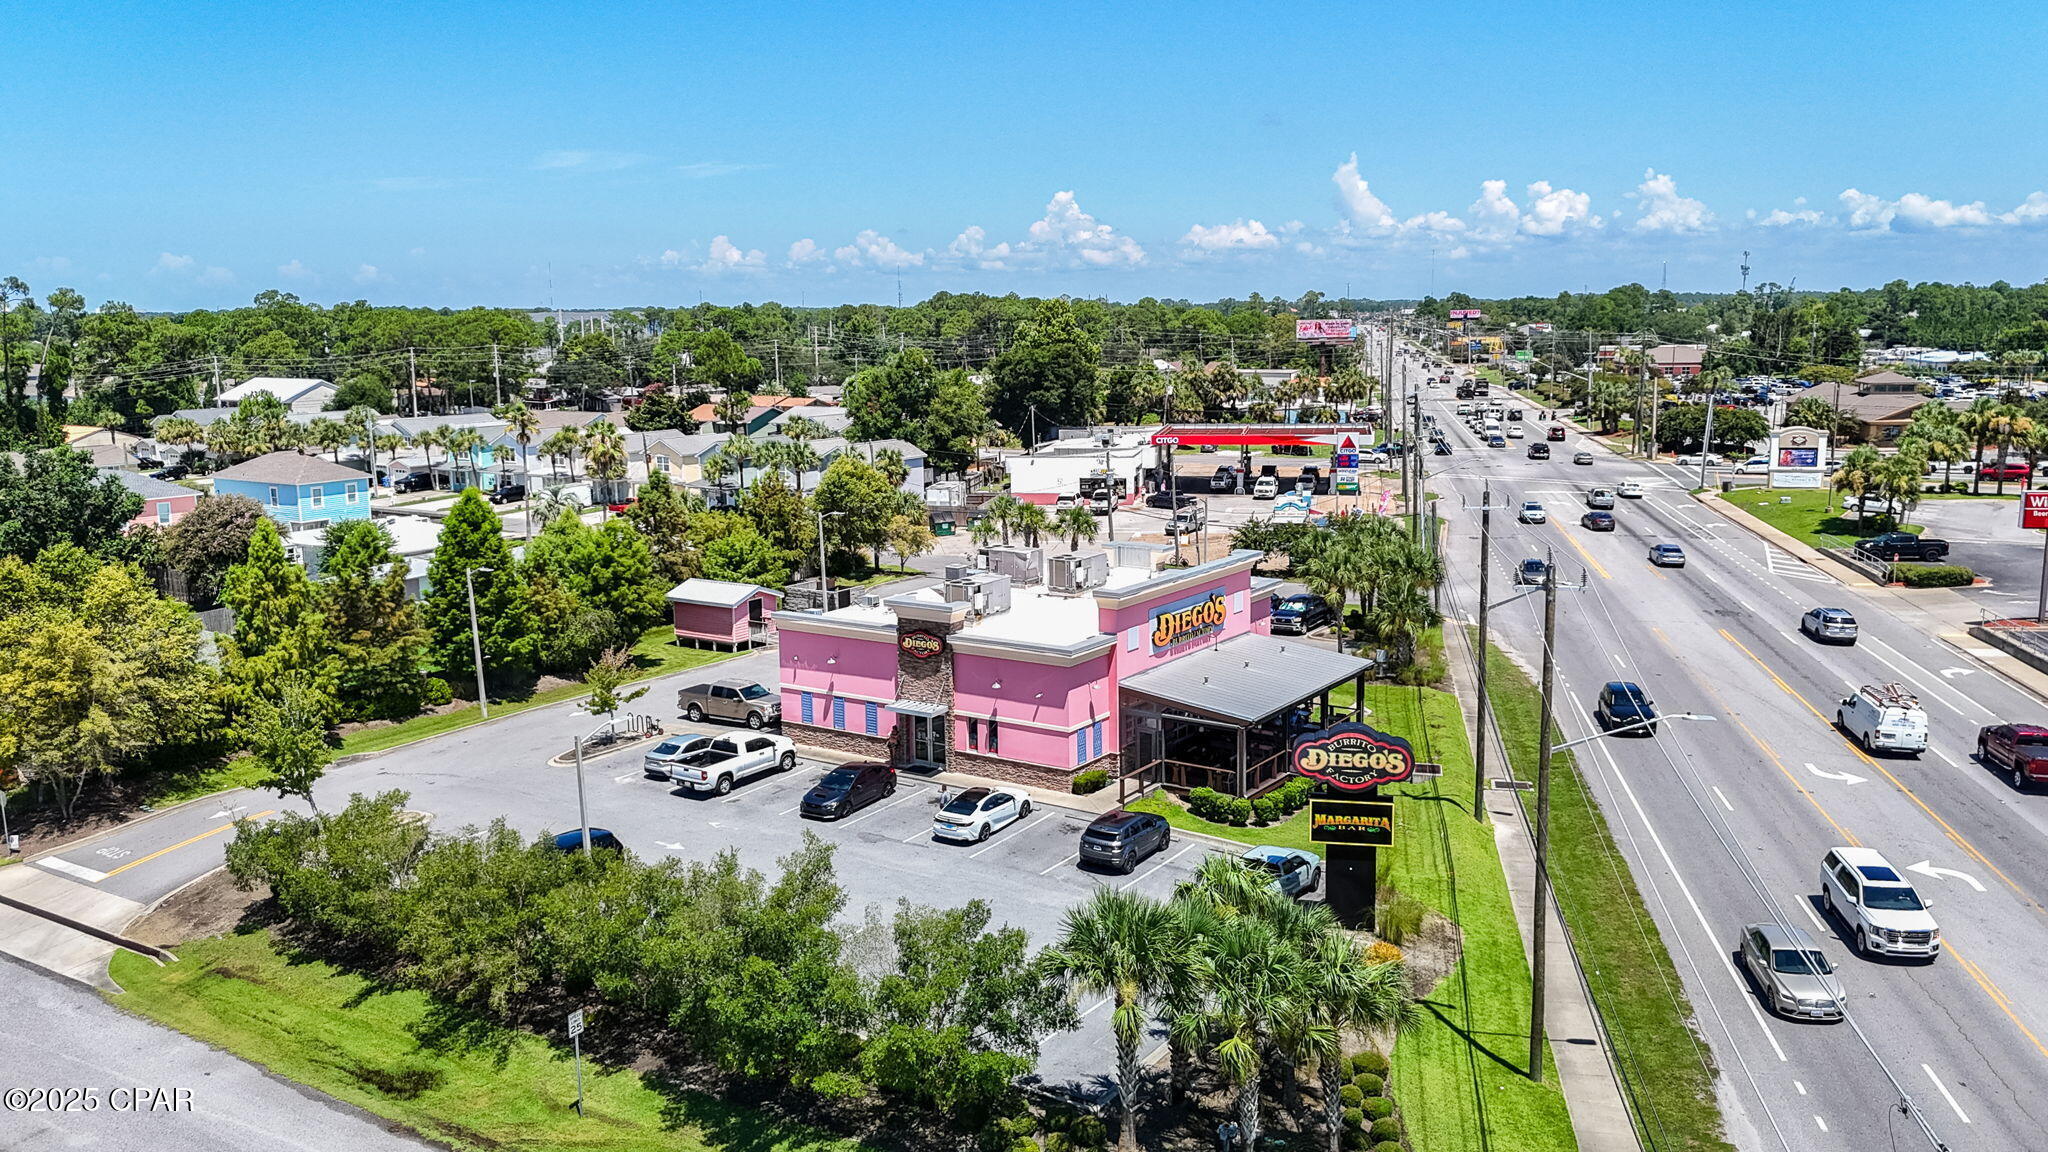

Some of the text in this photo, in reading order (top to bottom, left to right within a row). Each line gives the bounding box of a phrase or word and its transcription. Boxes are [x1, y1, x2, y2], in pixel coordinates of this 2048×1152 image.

[1153, 594, 1226, 646] DIEGO'S
[902, 637, 940, 651] DIEGO'S
[1327, 738, 1377, 752] BURRITO
[1300, 748, 1406, 774] DIEGO'S
[1325, 767, 1378, 784] FACTORY
[1312, 813, 1391, 832] MARGARITA
[570, 1022, 582, 1034] 25
